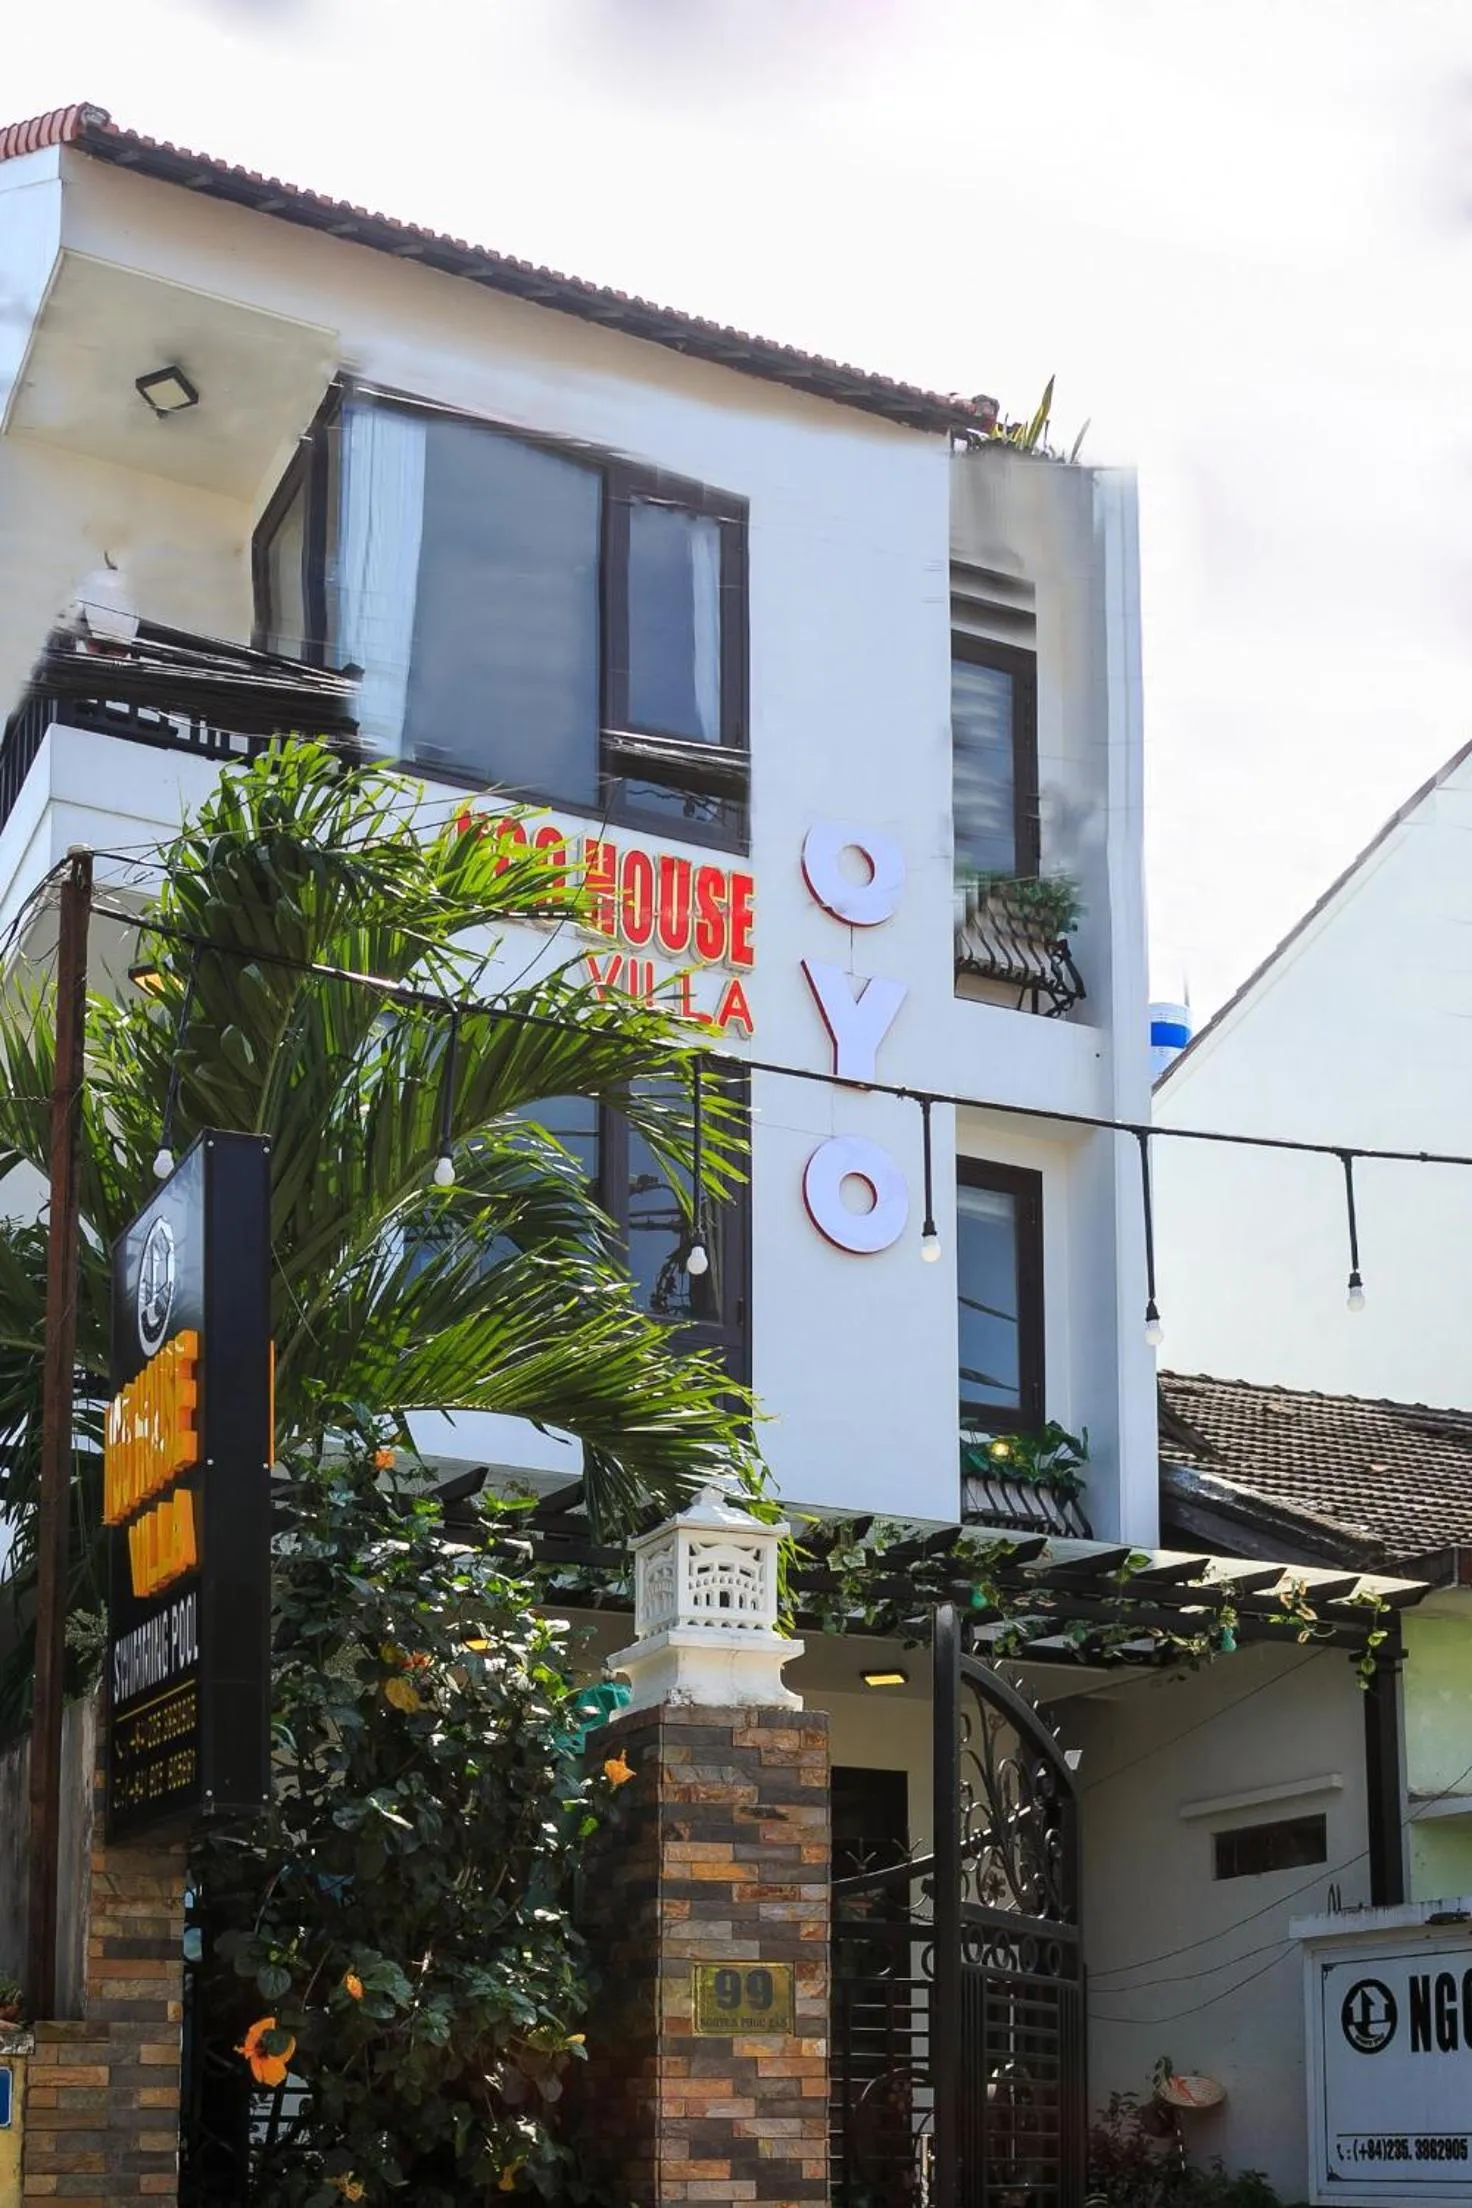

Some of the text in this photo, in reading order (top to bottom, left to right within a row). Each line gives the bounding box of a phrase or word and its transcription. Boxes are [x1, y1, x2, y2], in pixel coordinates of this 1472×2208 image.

[580, 836, 755, 969] HOUSE
[803, 820, 908, 1255] OYO
[113, 1591, 199, 1704] SWIMMING POOL
[714, 1968, 774, 2010] 99
